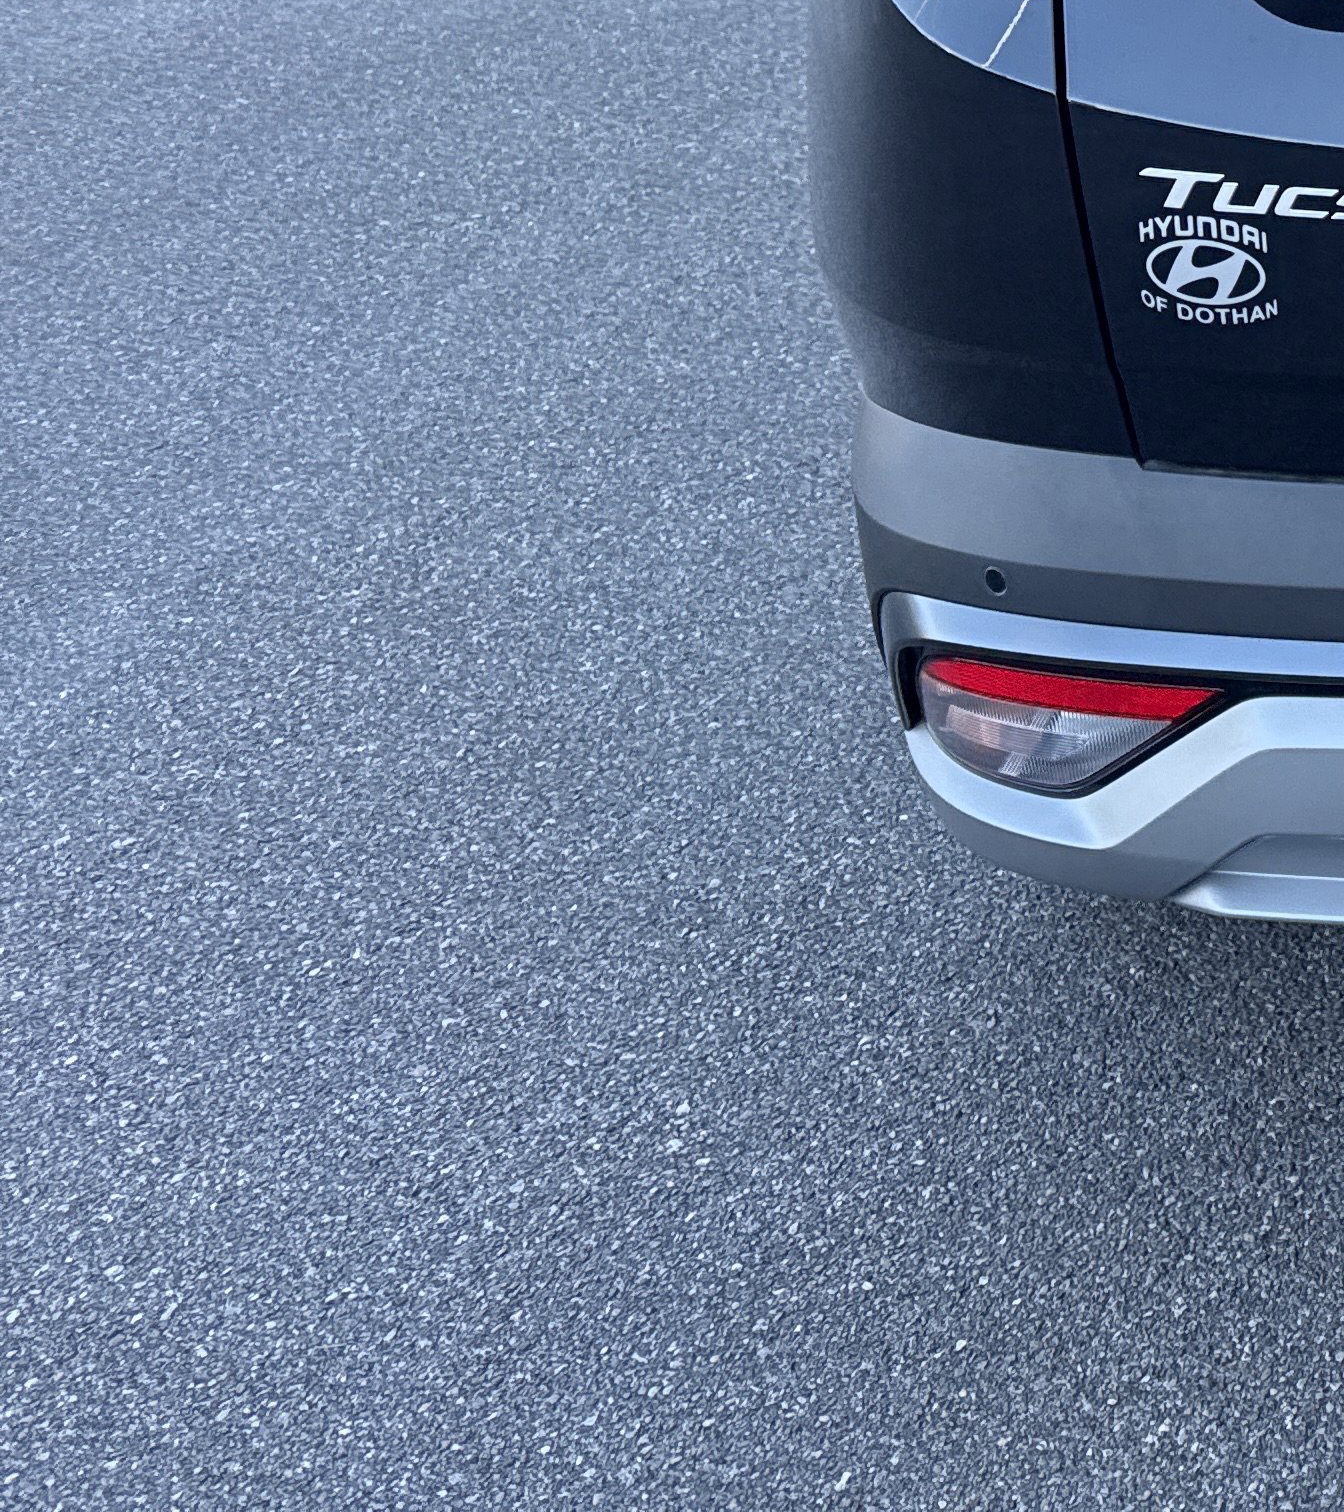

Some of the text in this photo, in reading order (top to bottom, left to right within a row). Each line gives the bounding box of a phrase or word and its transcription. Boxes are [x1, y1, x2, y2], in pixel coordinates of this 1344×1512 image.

[1138, 215, 1268, 254] HYUNDAI
[1140, 289, 1279, 326] OF DOTHAN
